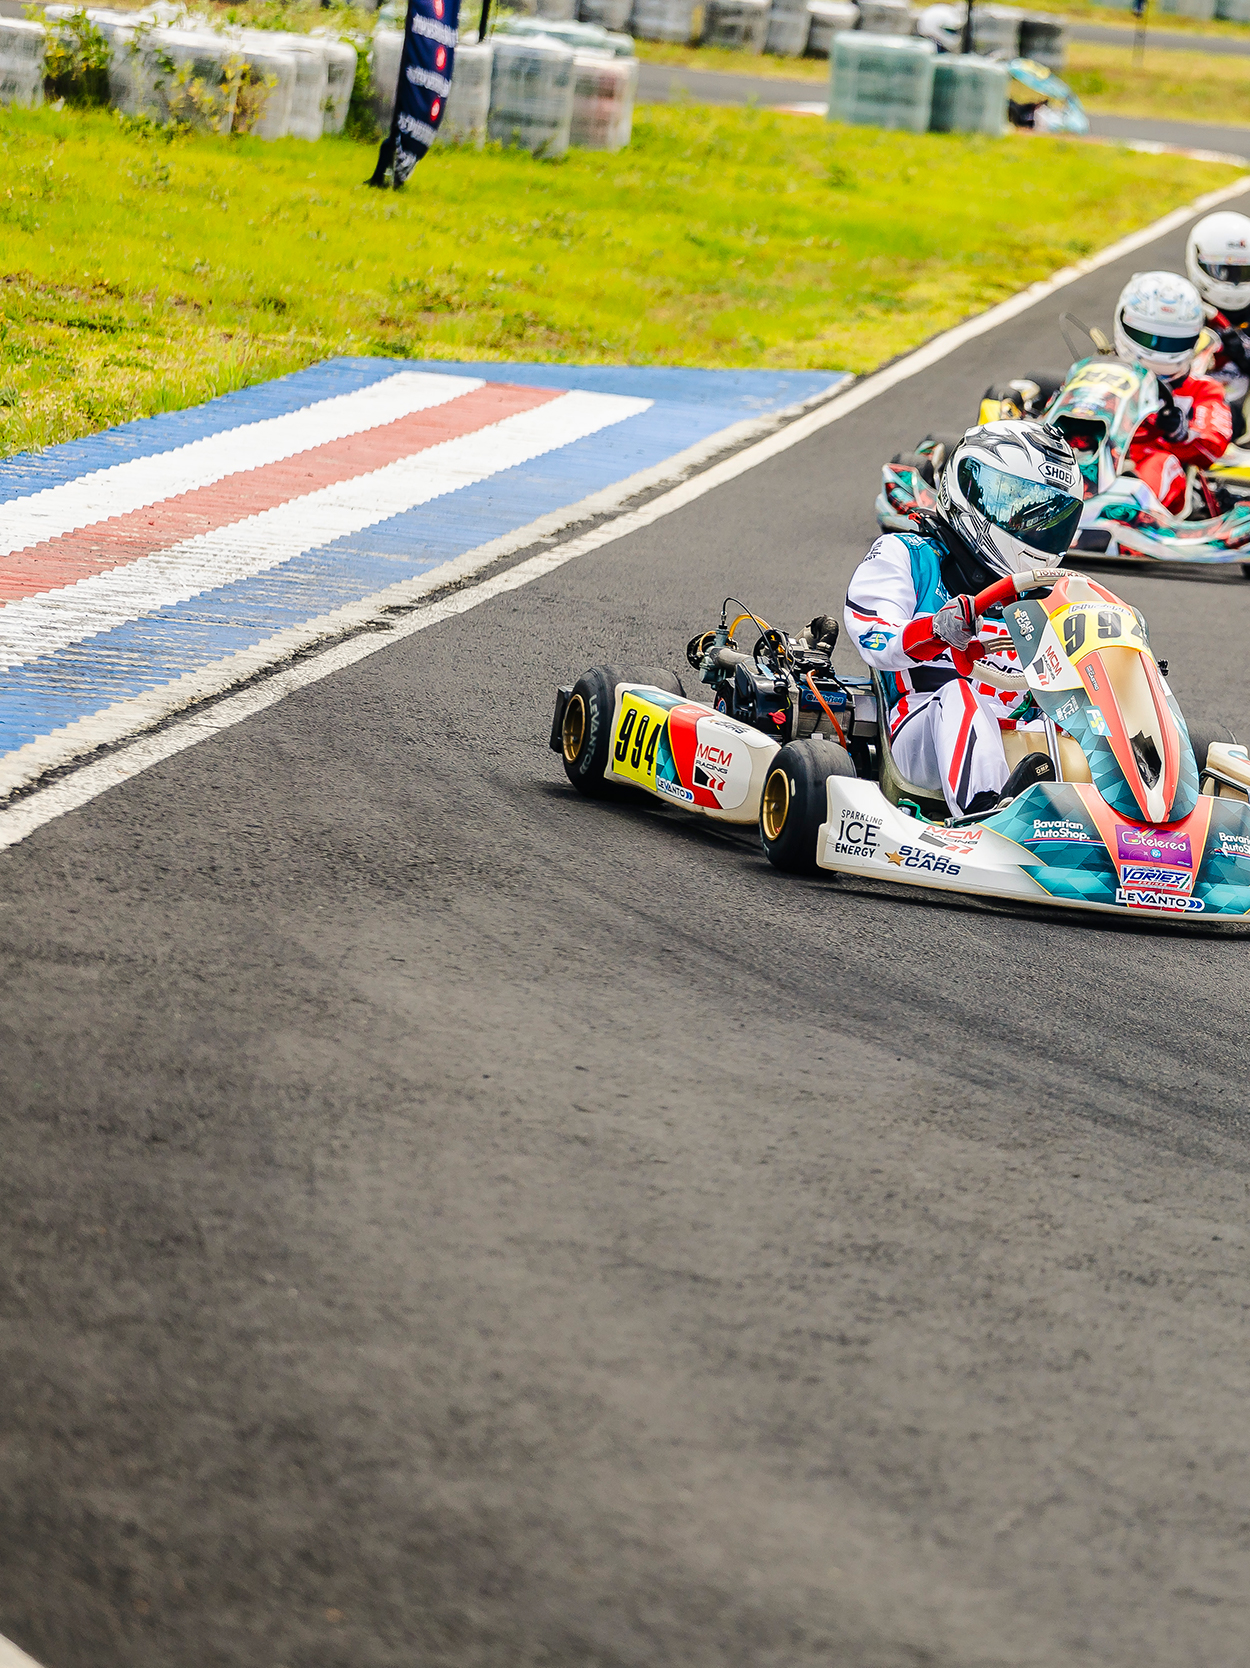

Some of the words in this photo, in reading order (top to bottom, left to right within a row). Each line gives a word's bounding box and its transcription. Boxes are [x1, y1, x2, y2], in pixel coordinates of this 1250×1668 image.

[1045, 465, 1072, 485] SHOEI
[1016, 617, 1033, 642] CAS
[1045, 645, 1063, 677] MCM
[583, 694, 599, 768] LEVANTO
[615, 708, 662, 776] 994
[697, 743, 733, 767] MCM
[695, 760, 729, 775] RACING
[1035, 764, 1050, 775] OMP
[657, 777, 686, 798] LEVANTO
[841, 809, 884, 826] SPARKLING
[1033, 819, 1084, 830] Bavarian
[838, 820, 880, 847] ICE
[926, 825, 983, 840] MCM
[835, 843, 876, 858] ENERGY
[898, 845, 952, 864] STAR
[904, 857, 962, 876] CARS
[1123, 867, 1187, 885] VORTEX
[1118, 891, 1187, 907] LEVANTO
